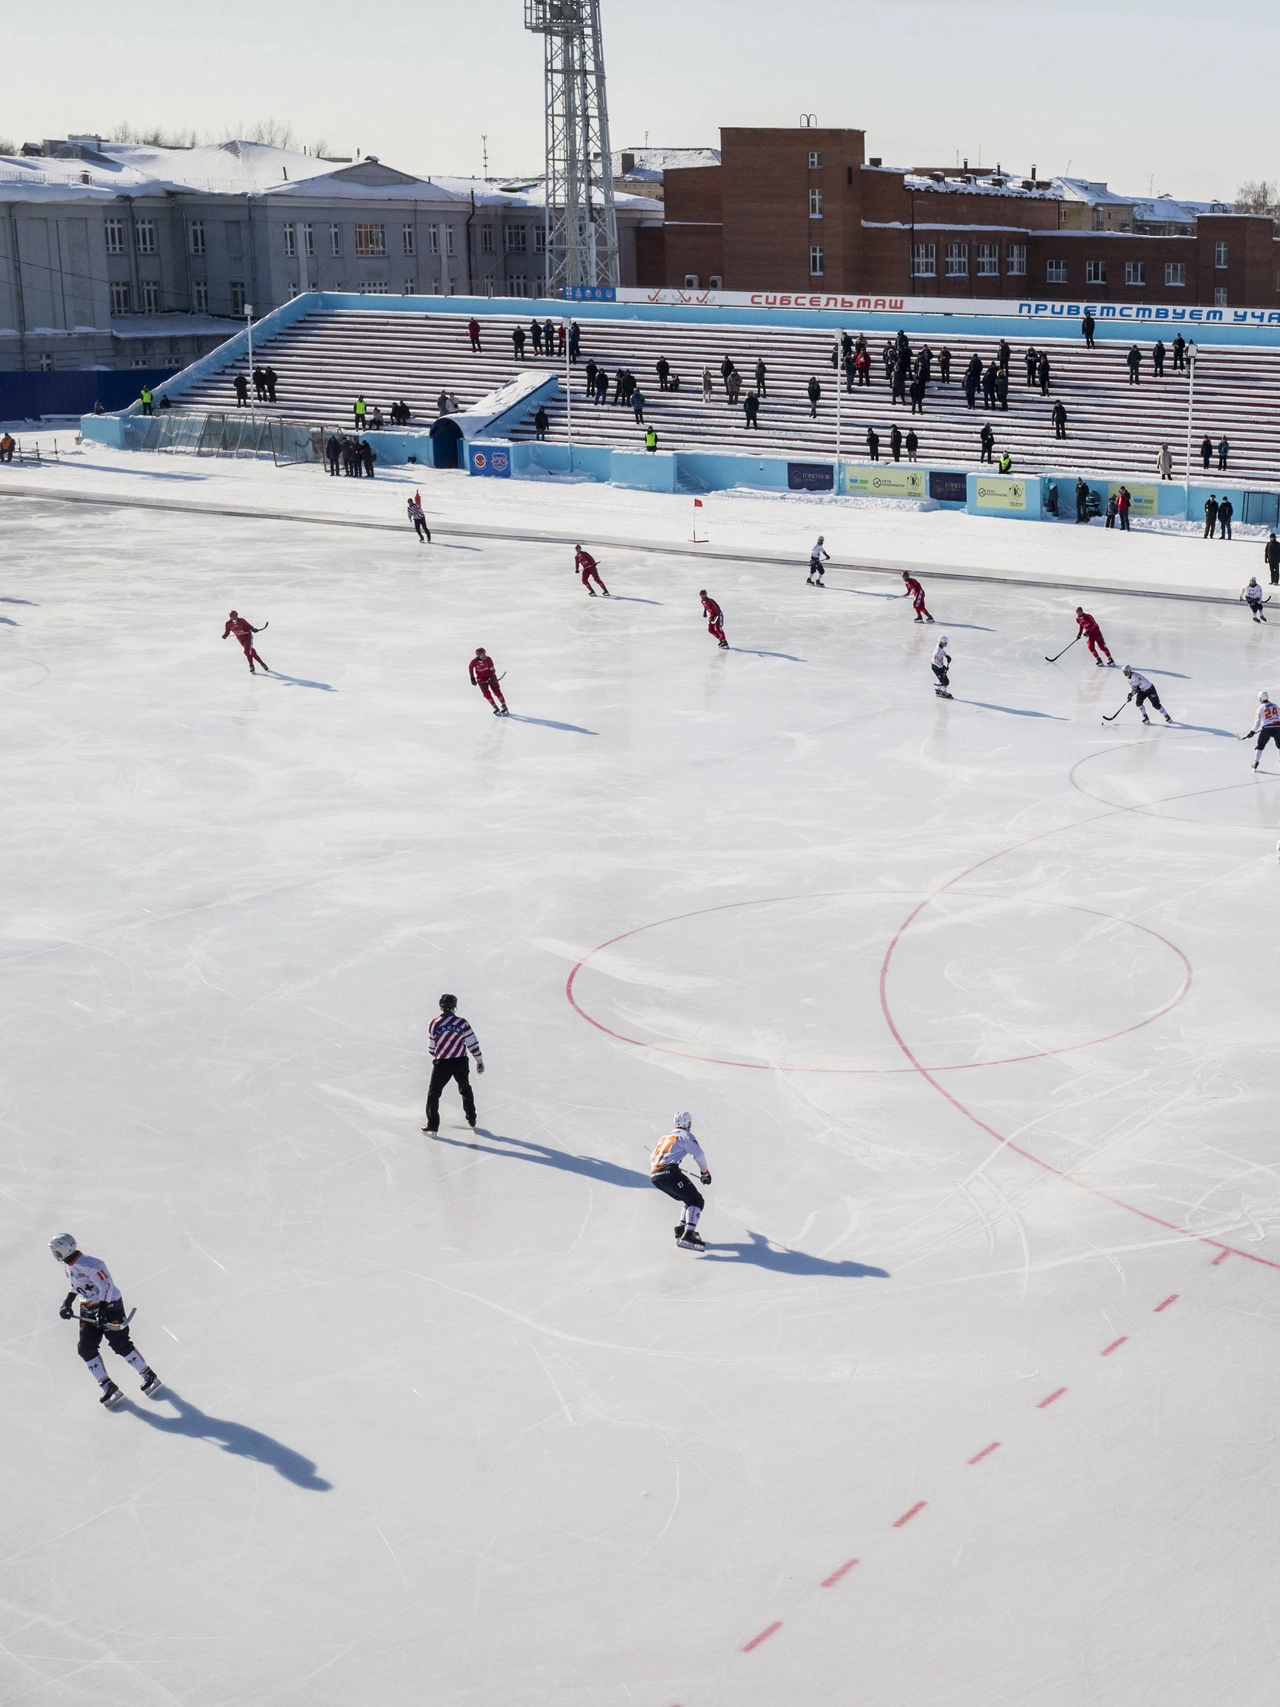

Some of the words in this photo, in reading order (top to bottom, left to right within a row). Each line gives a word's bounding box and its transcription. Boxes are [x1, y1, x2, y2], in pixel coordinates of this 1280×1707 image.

[750, 294, 904, 310] СИБСЕЛЬМАШ
[1018, 303, 1223, 321] ПРИВЕТСТВУЕМ
[1264, 706, 1279, 720] 24
